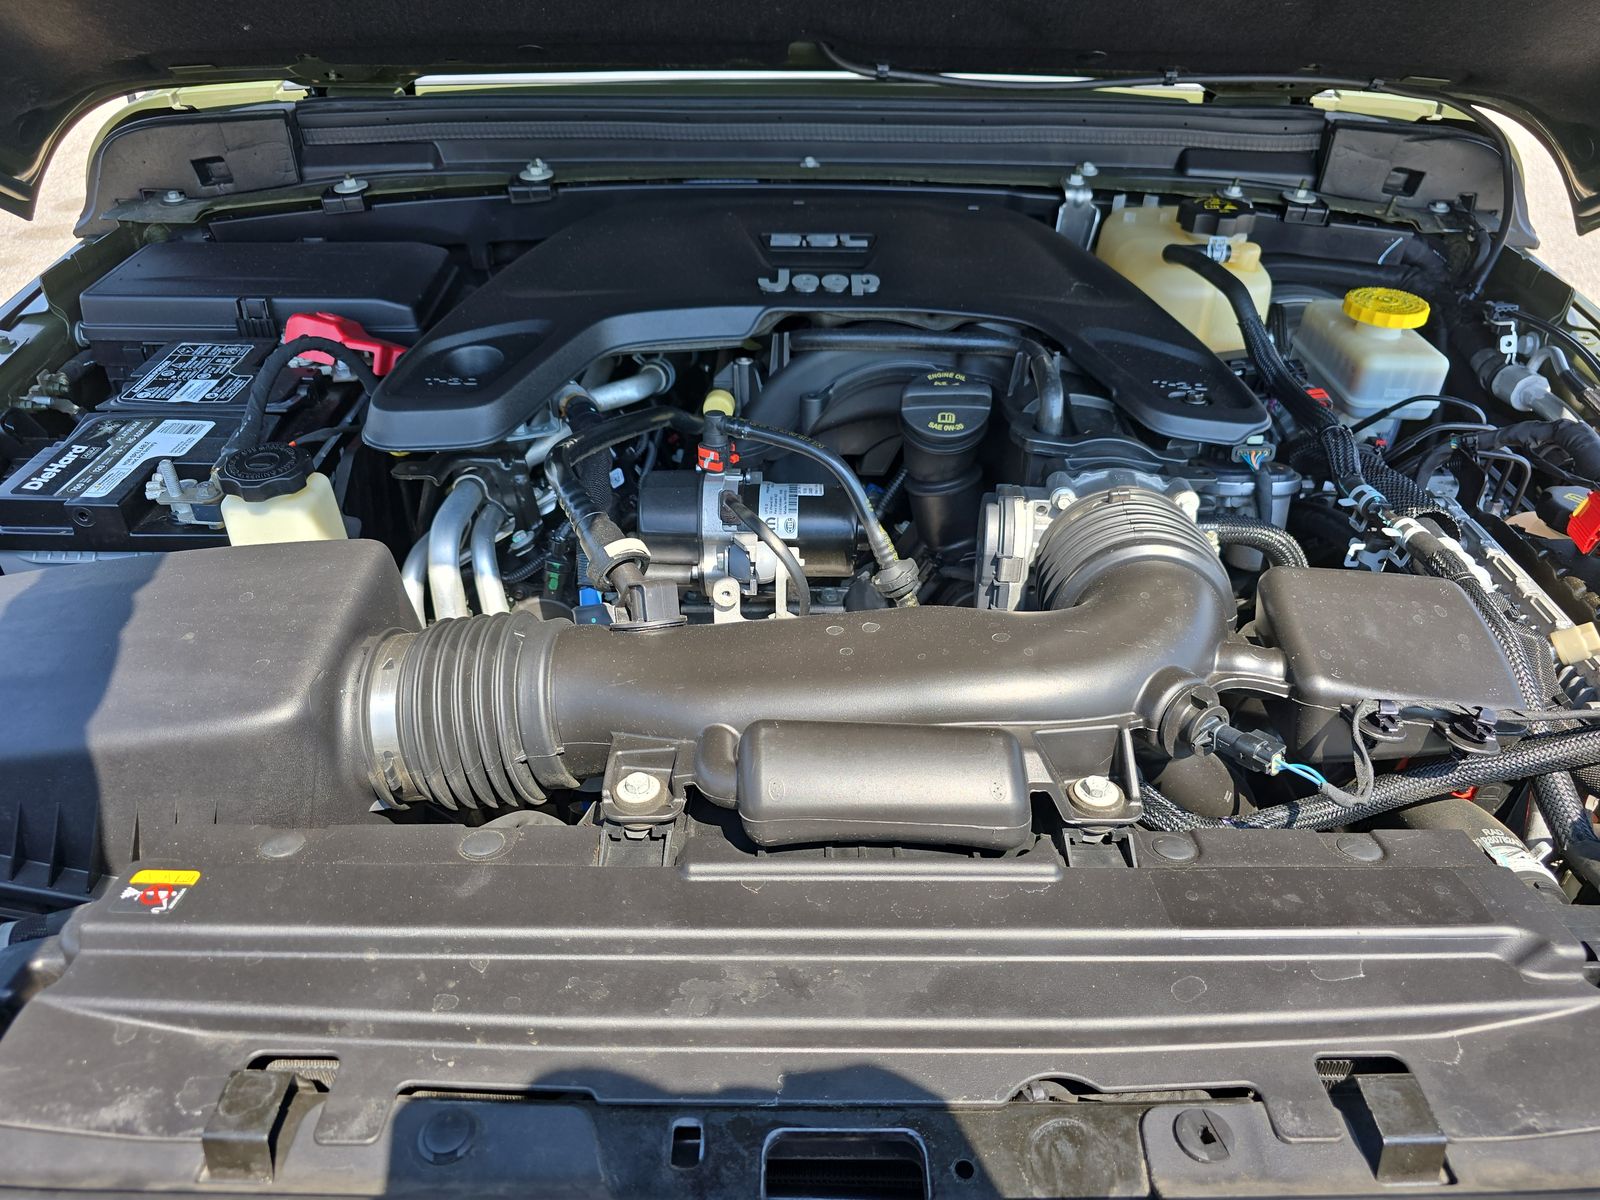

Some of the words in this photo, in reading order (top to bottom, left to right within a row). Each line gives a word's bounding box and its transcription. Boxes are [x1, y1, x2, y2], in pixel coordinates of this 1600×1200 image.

[927, 372, 954, 380] ENGINE
[928, 421, 943, 431] SAE
[943, 422, 964, 431] 0W-20
[22, 444, 89, 491] DieHard
